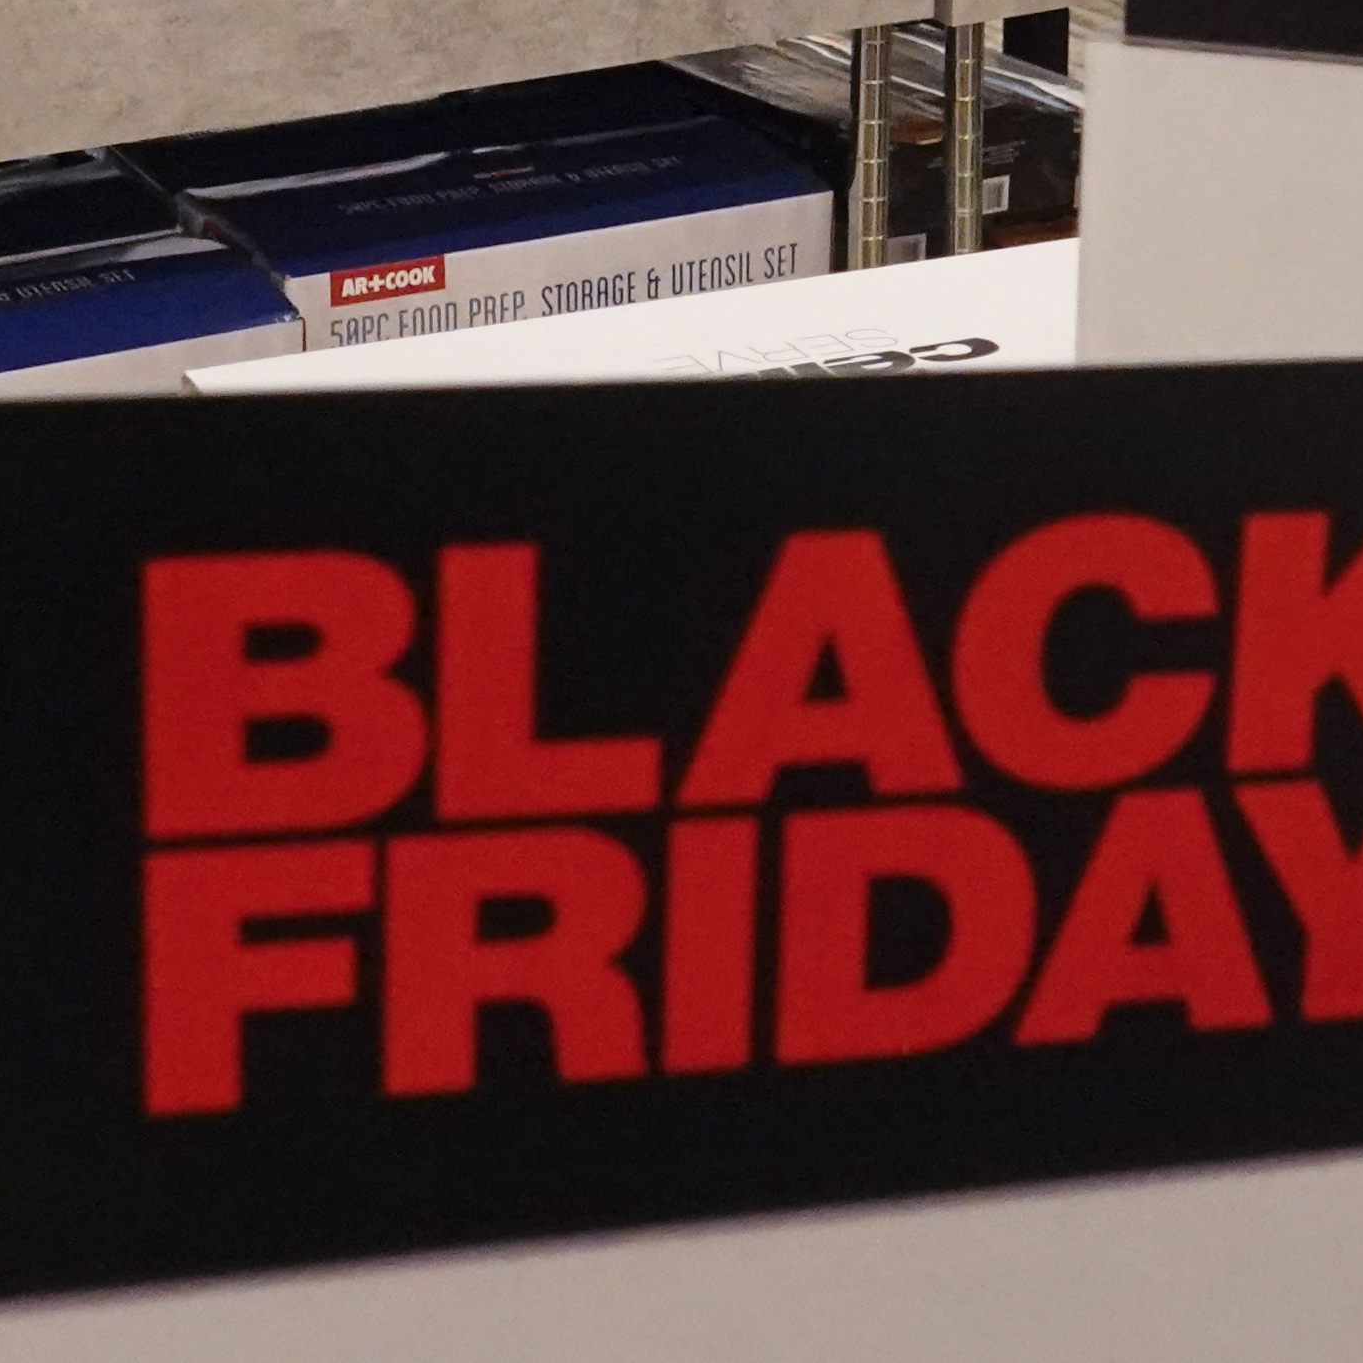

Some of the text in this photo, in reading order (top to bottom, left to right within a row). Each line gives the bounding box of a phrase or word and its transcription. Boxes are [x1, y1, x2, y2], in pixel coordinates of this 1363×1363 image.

[341, 264, 436, 298] AR+COOK
[399, 302, 458, 338] FOOD
[541, 271, 636, 317] STORAGE
[647, 268, 661, 301] &
[671, 251, 754, 296] UTENSIL
[764, 243, 798, 280] SET
